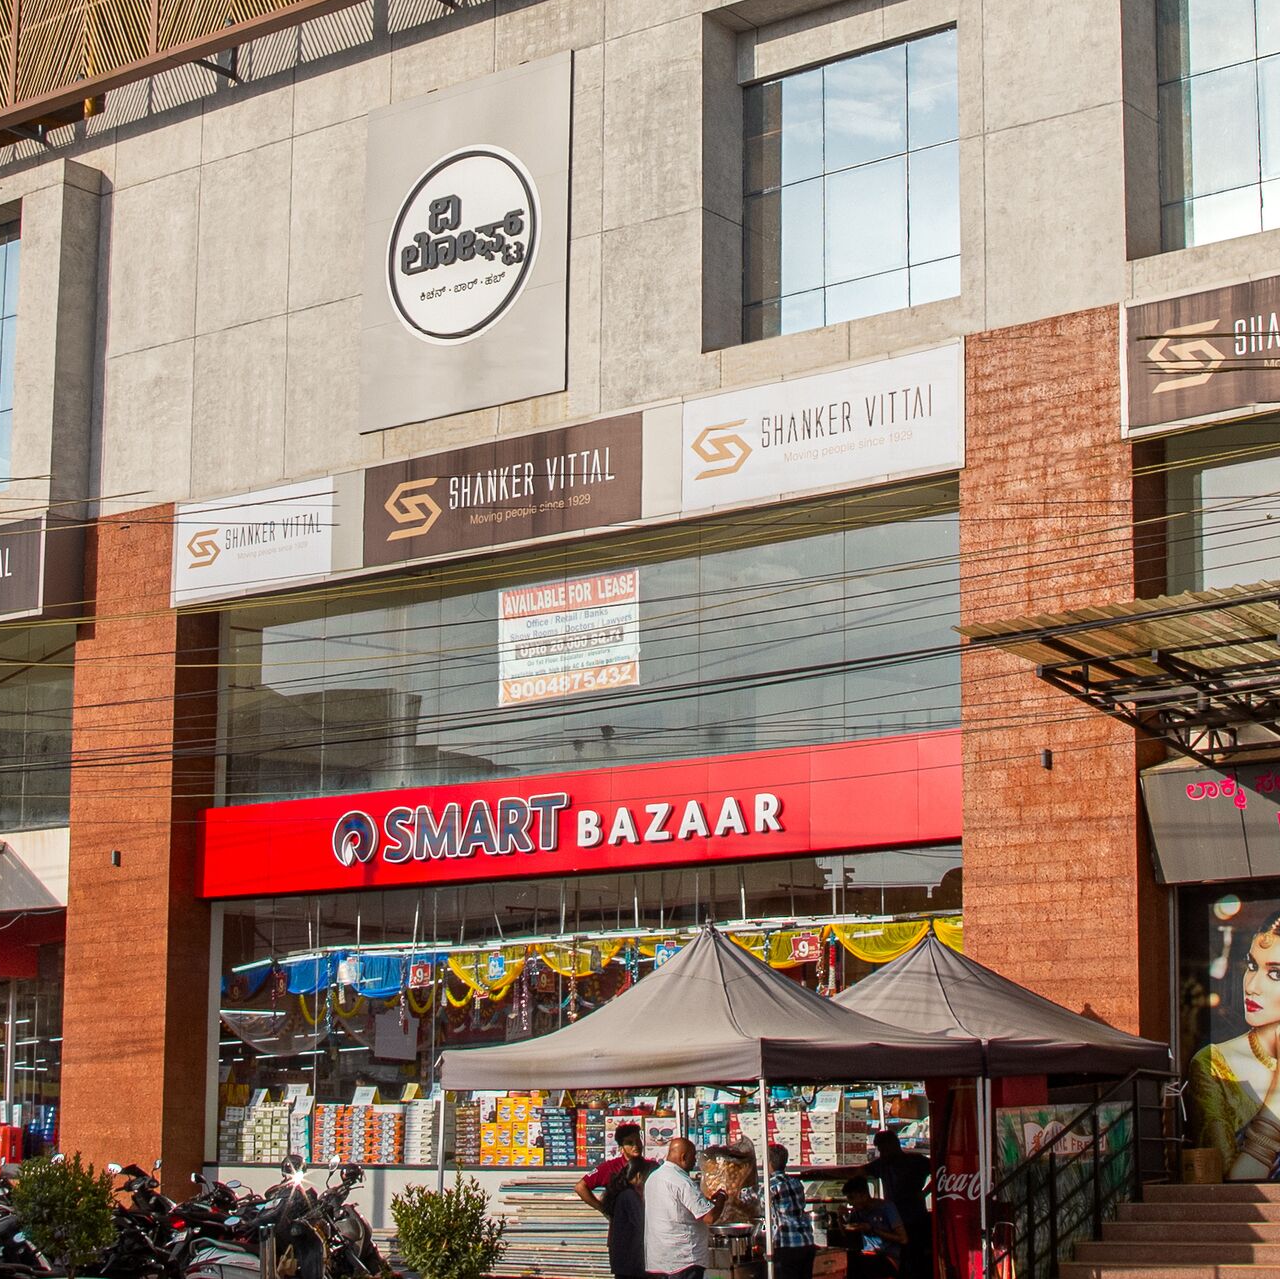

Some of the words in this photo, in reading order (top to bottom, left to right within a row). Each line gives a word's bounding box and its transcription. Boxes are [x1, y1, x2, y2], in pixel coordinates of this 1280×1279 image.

[760, 400, 852, 449] SHANKER
[783, 448, 820, 464] Moving
[821, 439, 857, 458] people
[858, 433, 886, 449] since
[888, 428, 914, 445] 1929
[448, 461, 535, 511] SHANKER
[546, 446, 616, 492] VITTAL
[470, 510, 504, 526] Moving
[505, 502, 538, 522] people
[539, 498, 565, 513] since
[568, 492, 592, 508] 1929
[224, 519, 276, 550] SHANKER
[282, 511, 322, 540] VITTAL
[505, 583, 567, 616] AVAILABLE
[568, 581, 593, 605] FOR
[597, 573, 635, 599] LEASE
[526, 617, 550, 629] Office
[555, 613, 578, 624] Retail
[584, 608, 609, 619] Banks
[509, 665, 633, 698] 9004875432
[383, 792, 571, 863] SMART
[577, 792, 783, 848] BAZAAR
